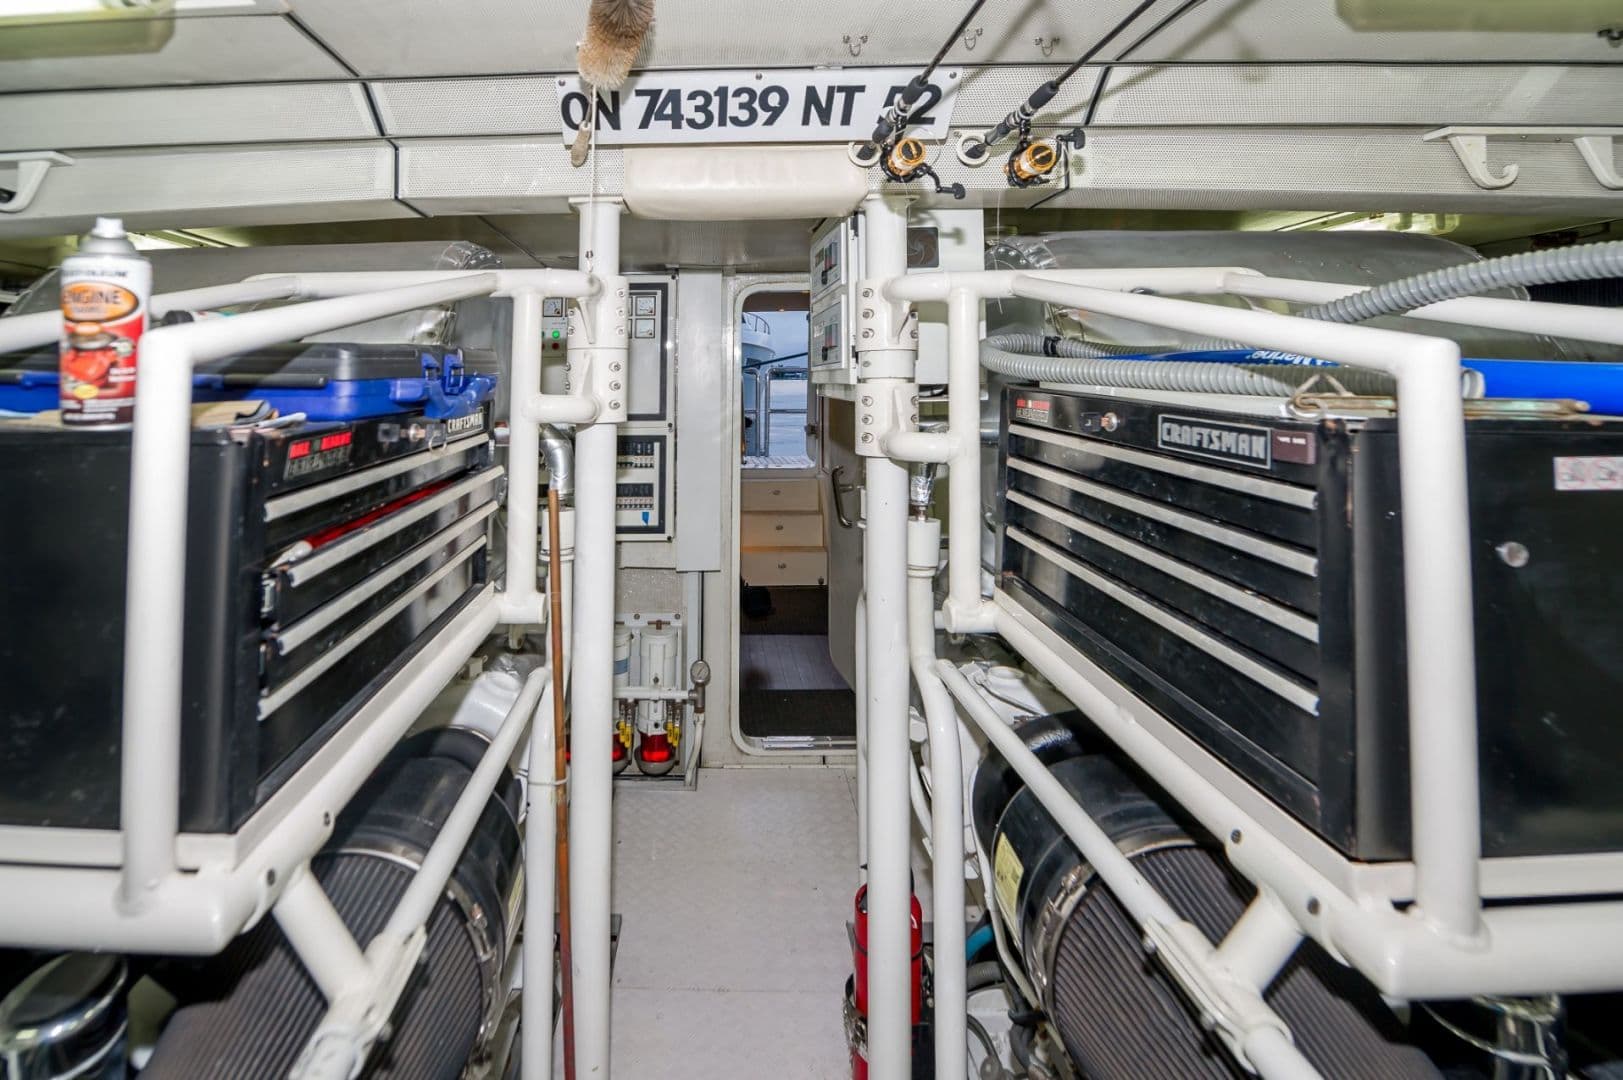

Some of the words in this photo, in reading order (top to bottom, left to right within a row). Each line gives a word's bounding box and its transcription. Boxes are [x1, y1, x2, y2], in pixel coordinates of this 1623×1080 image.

[561, 90, 621, 131] ON
[634, 85, 789, 130] 743139
[801, 84, 866, 126] NT
[447, 412, 484, 433] CRAFTSMAN
[1161, 422, 1267, 459] CRAFTSMAN
